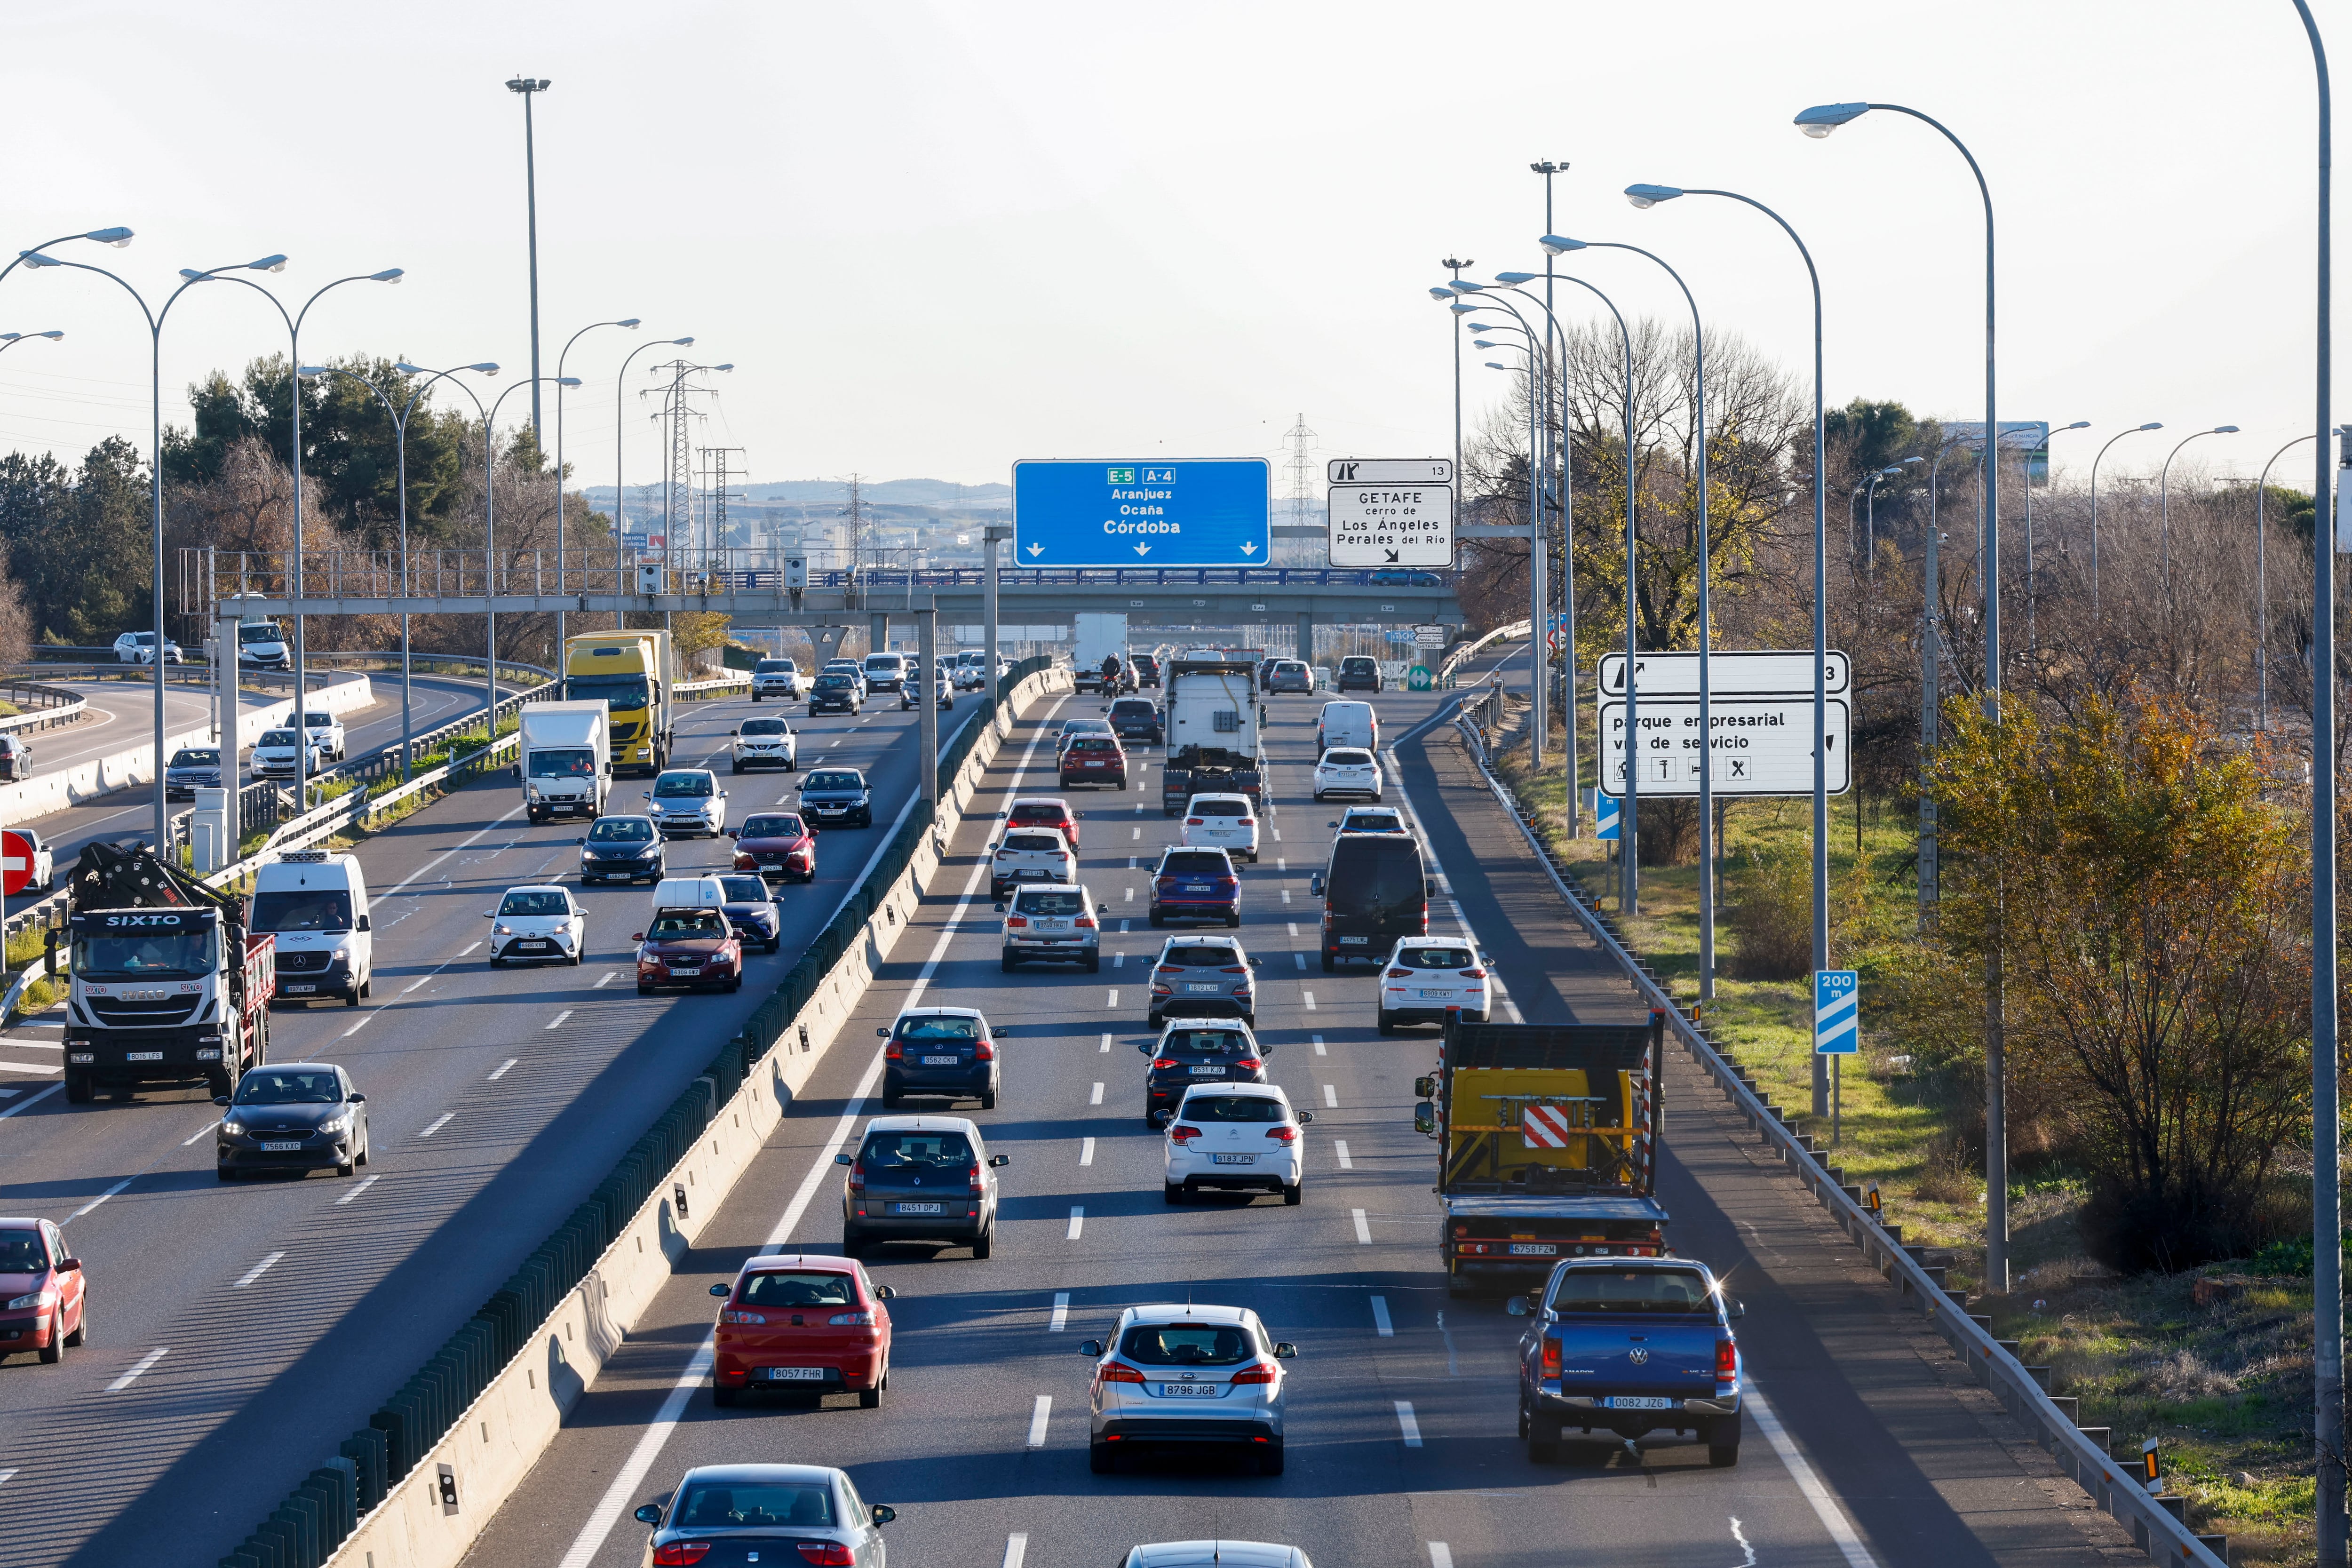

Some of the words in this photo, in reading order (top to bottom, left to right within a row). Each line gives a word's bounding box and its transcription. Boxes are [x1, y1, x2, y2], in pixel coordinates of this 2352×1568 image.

[1110, 471, 1133, 482] E-5
[1146, 471, 1172, 481] A-4
[1112, 489, 1171, 501] Aranjuez
[1359, 493, 1422, 503] GETAFE
[1120, 505, 1163, 515] Ocaña
[1104, 520, 1180, 533] Córdoba
[1343, 521, 1367, 531] Los
[1378, 518, 1438, 533] Ángeles
[1337, 535, 1392, 544] Perales
[1426, 536, 1445, 544] Río
[1613, 717, 1671, 731] prque
[1651, 737, 1670, 749] de
[1683, 735, 1749, 749] sevicio
[106, 915, 181, 926] SIXTO
[1822, 975, 1851, 987] 200
[181, 983, 202, 992] SIXTO
[122, 989, 165, 999] IVECO
[1831, 989, 1842, 997] m
[1515, 1245, 1536, 1253] 6758
[776, 1369, 800, 1378] 8057
[803, 1369, 821, 1378] FHR
[1168, 1385, 1193, 1394] 8796
[1196, 1385, 1215, 1395] JGB
[1615, 1398, 1641, 1407] 0082
[1645, 1398, 1664, 1408] JZG
